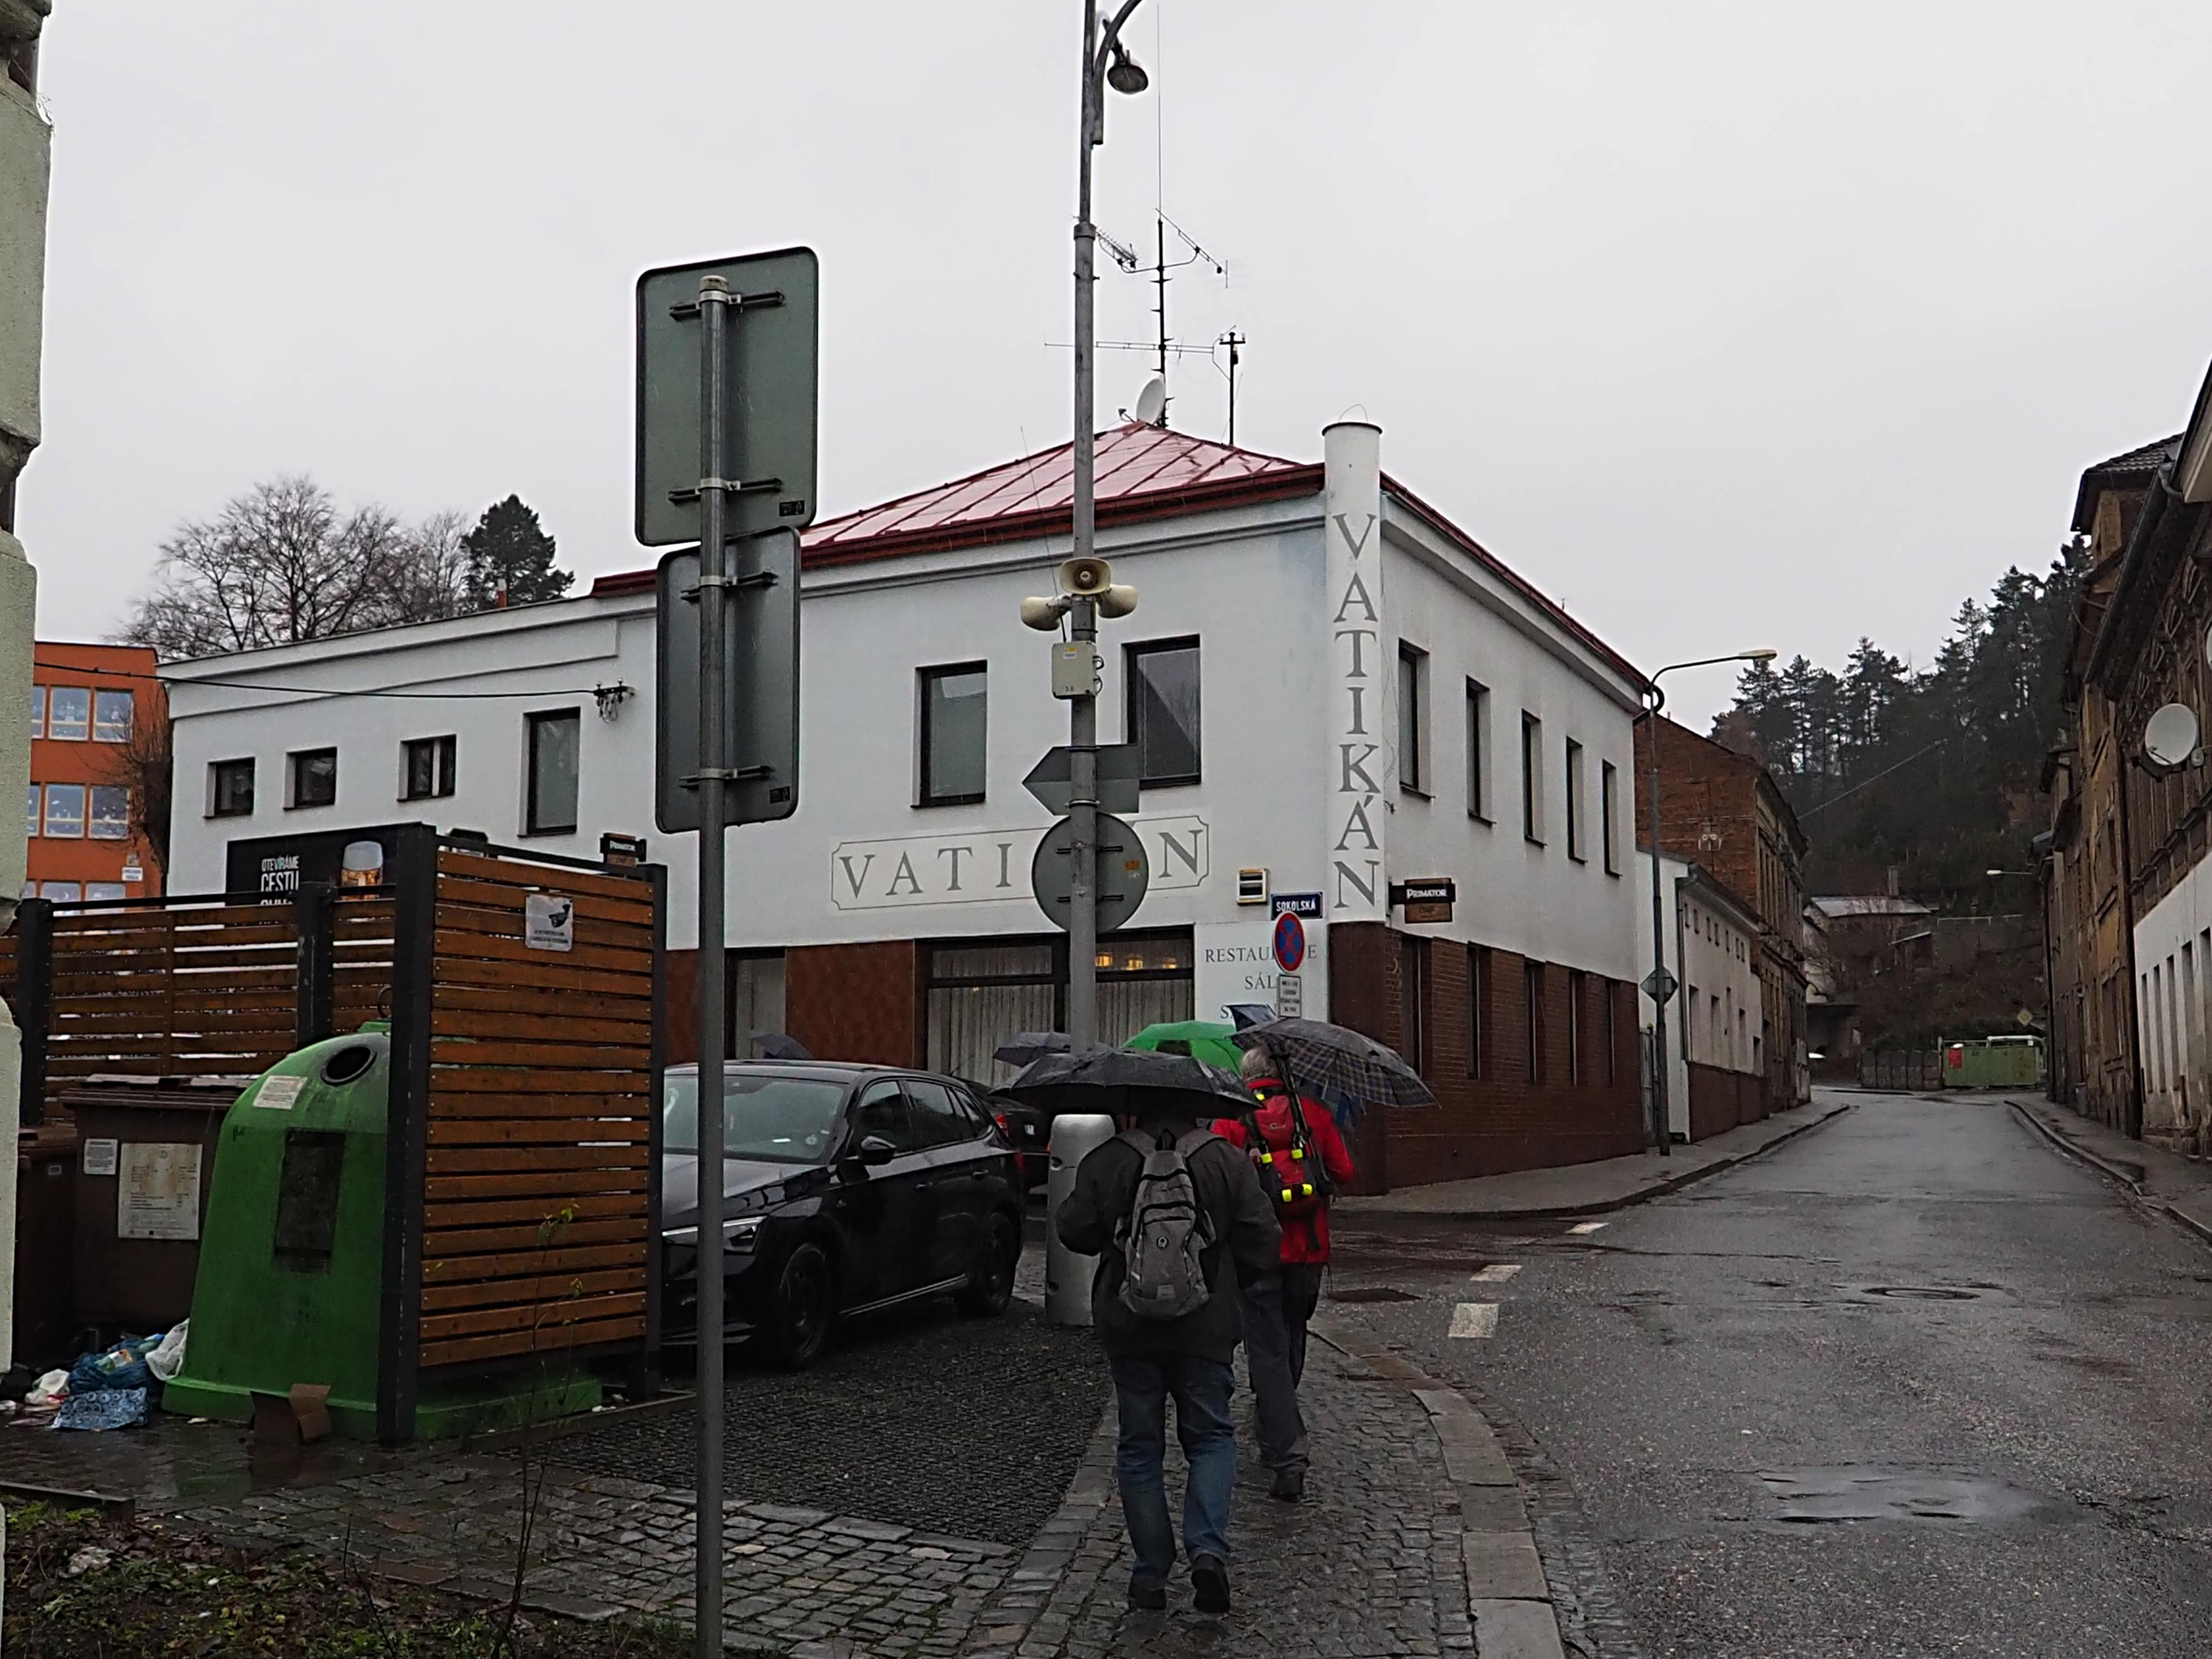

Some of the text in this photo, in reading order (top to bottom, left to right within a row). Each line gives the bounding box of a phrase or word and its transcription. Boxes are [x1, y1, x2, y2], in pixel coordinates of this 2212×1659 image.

[1332, 513, 1380, 909] VATIKÁN
[838, 829, 1203, 899] VATIN
[1276, 898, 1316, 912] SOKOLSKÁ
[1205, 945, 1317, 963] RESTAUE
[1244, 972, 1277, 990] SÁL
